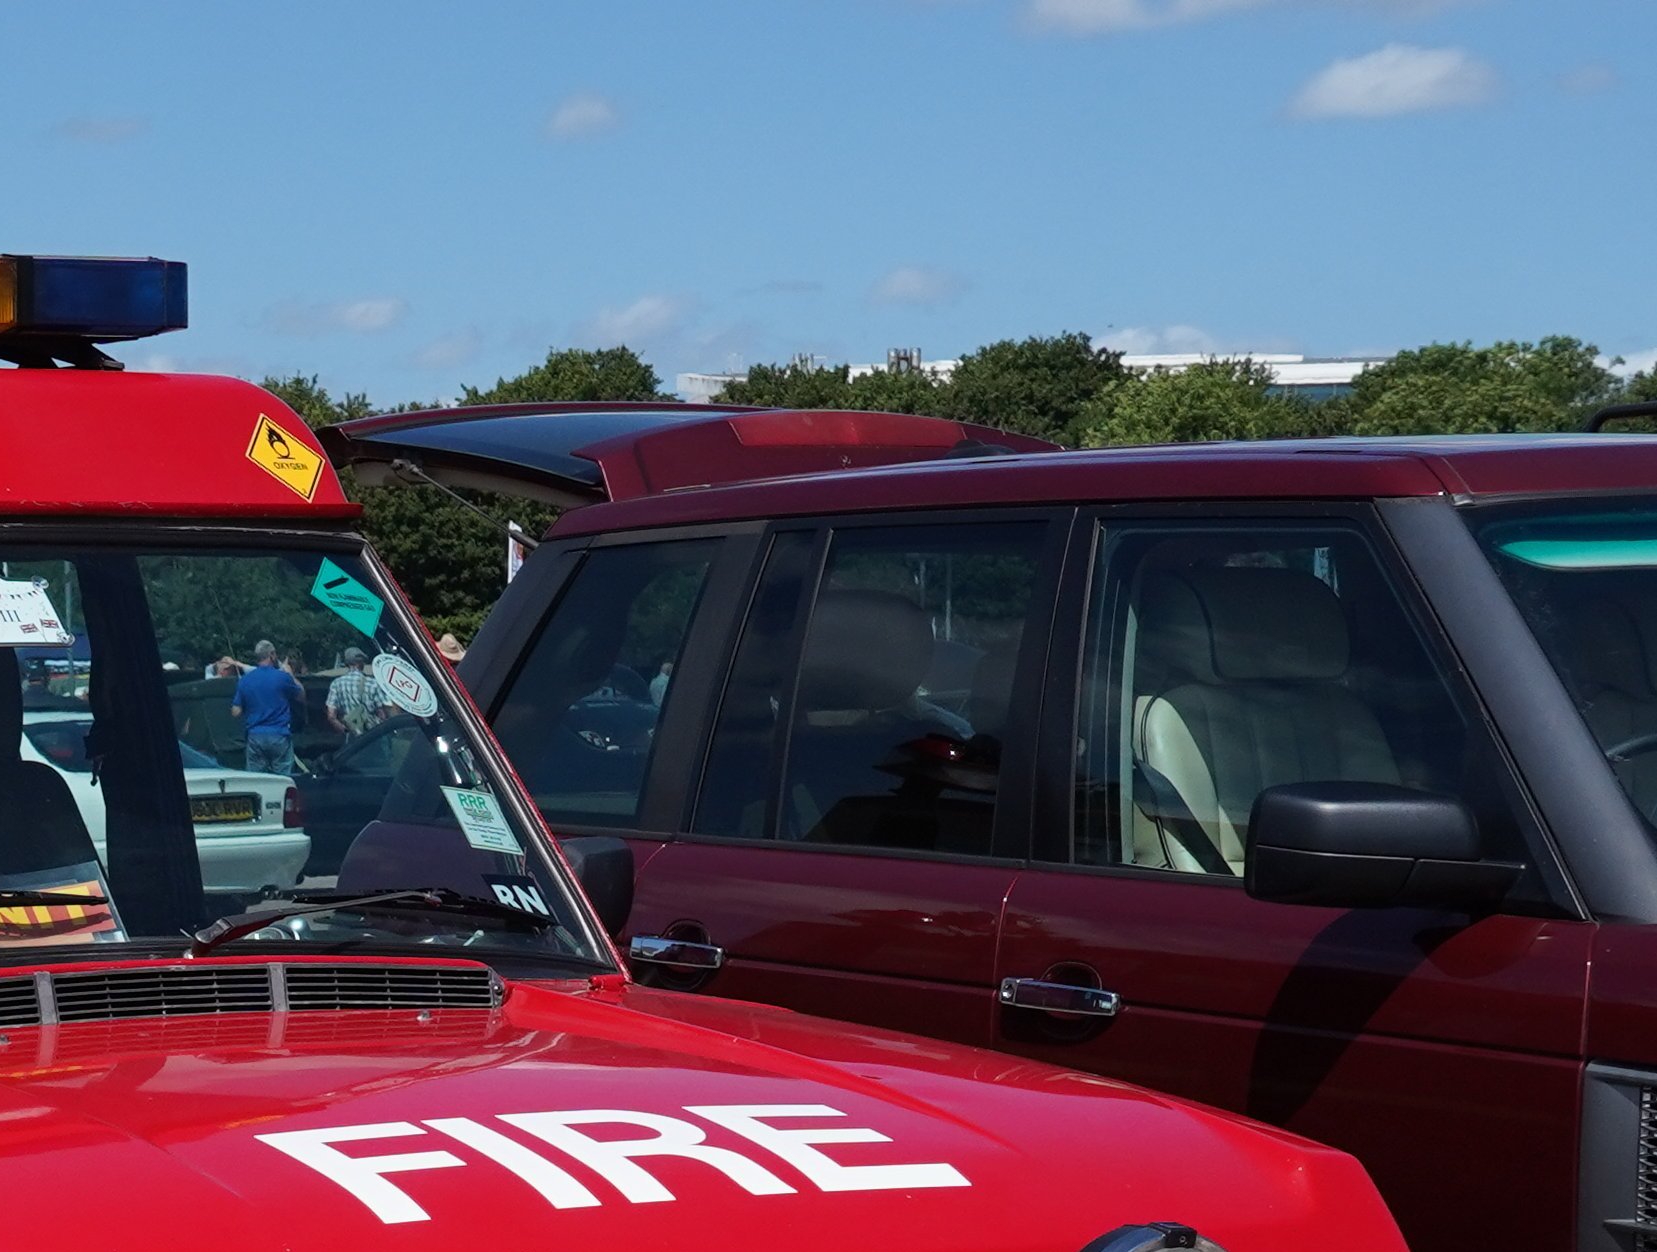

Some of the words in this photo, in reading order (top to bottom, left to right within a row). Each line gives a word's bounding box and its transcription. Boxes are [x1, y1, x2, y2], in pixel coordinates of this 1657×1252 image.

[273, 461, 309, 470] OXYGEN
[0, 608, 22, 623] III
[457, 793, 488, 810] RRR
[491, 884, 550, 916] RN
[253, 1104, 972, 1224] FIRE
